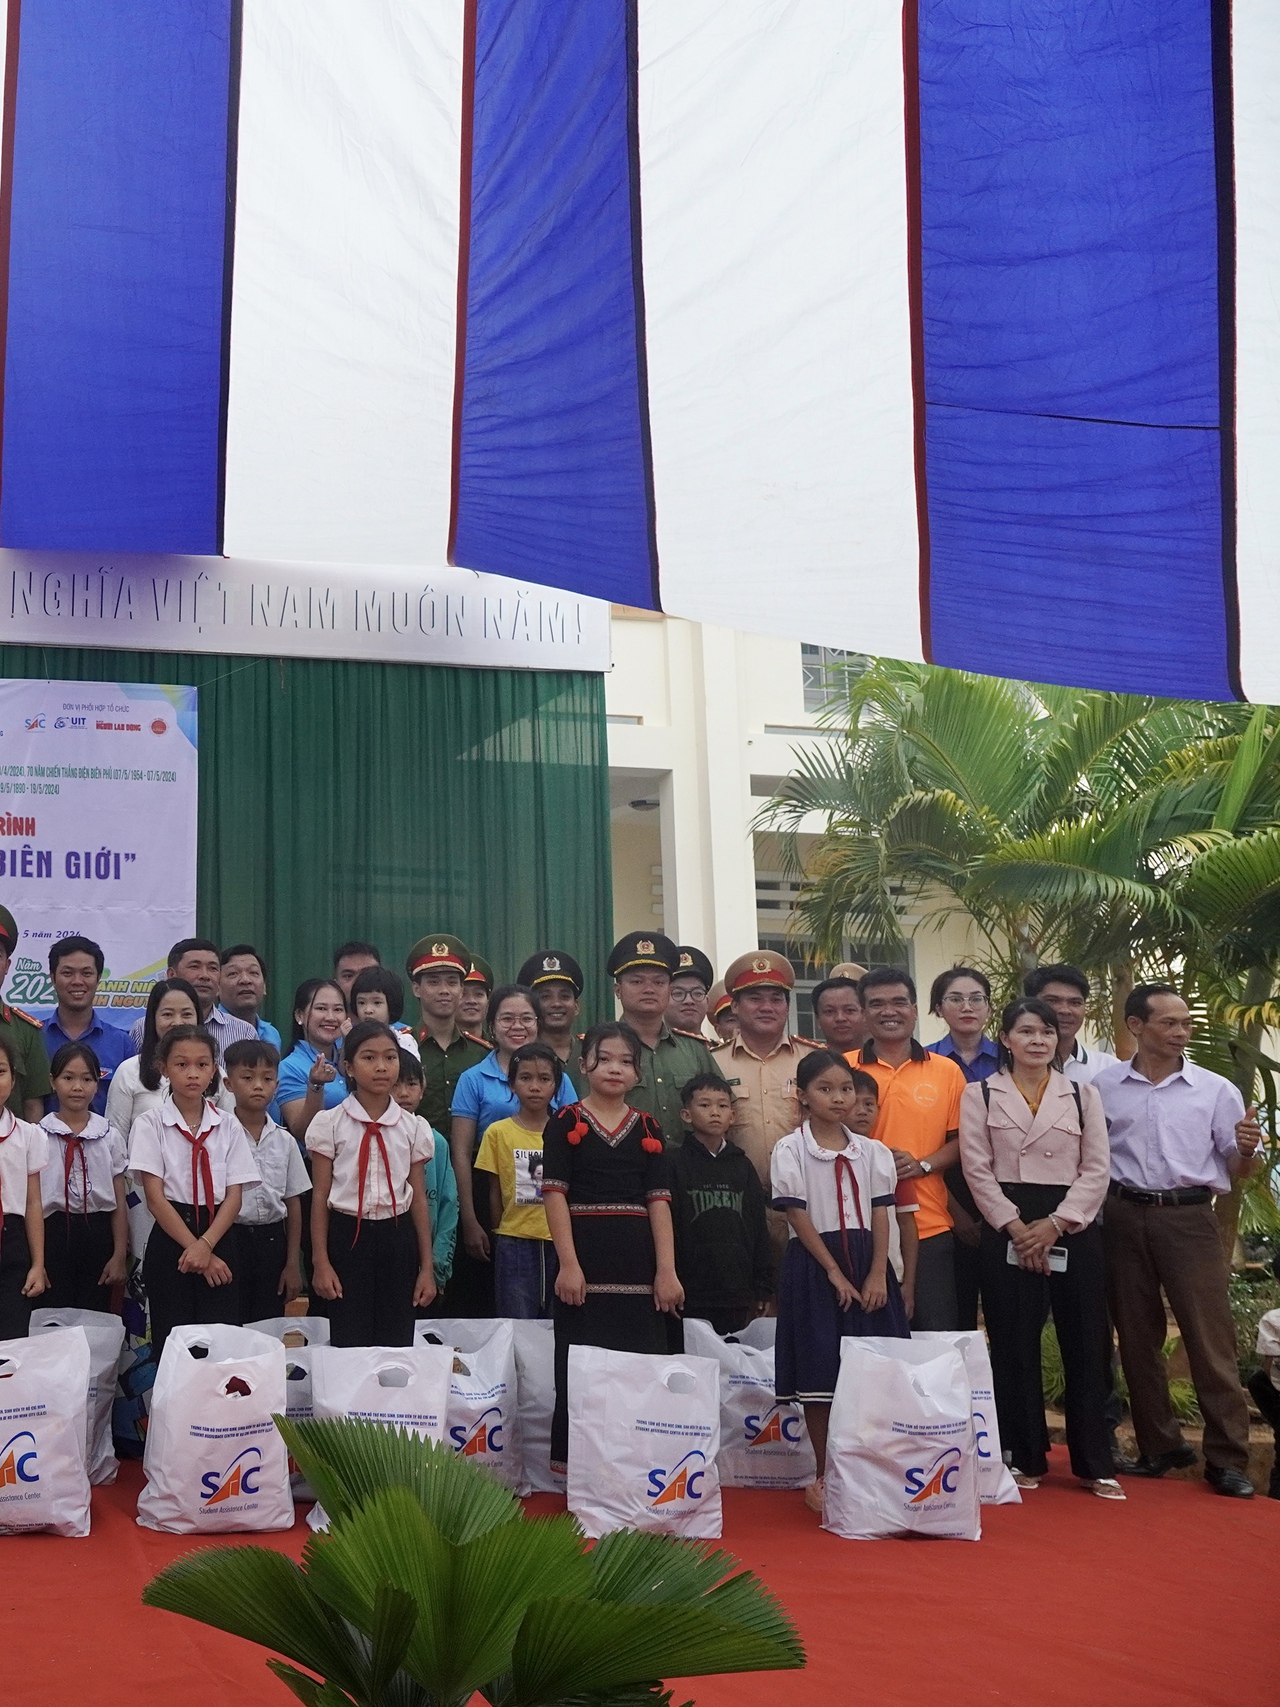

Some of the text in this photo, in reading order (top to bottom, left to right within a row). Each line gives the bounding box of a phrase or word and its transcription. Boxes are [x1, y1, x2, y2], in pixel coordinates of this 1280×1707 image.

[11, 566, 136, 622] NGHĨA
[151, 571, 229, 634] VIỆT
[251, 582, 338, 631] NAM
[354, 584, 467, 639] MUÔN
[483, 590, 584, 646] NĂM!
[62, 702, 130, 713] ĐƠN VỊ PHỐI HỢP TỔ CHỨC
[25, 718, 46, 730] SAC
[71, 717, 87, 725] UIT
[27, 766, 34, 777] 70
[34, 764, 45, 778] NĂM
[46, 764, 61, 778] CHIẾN
[90, 766, 102, 780] BIÊN
[65, 847, 137, 881] GIỚI”
[22, 930, 30, 938] 5
[9, 959, 54, 1000] Năm 202
[95, 979, 156, 993] ANH NIÊ
[449, 1422, 504, 1459] SAC
[744, 1412, 801, 1447] SAC
[24, 1492, 41, 1500] Center
[200, 1464, 261, 1506] SAC
[647, 1465, 705, 1506] SAC
[904, 1464, 960, 1503] SAC
[199, 1507, 218, 1515] Student
